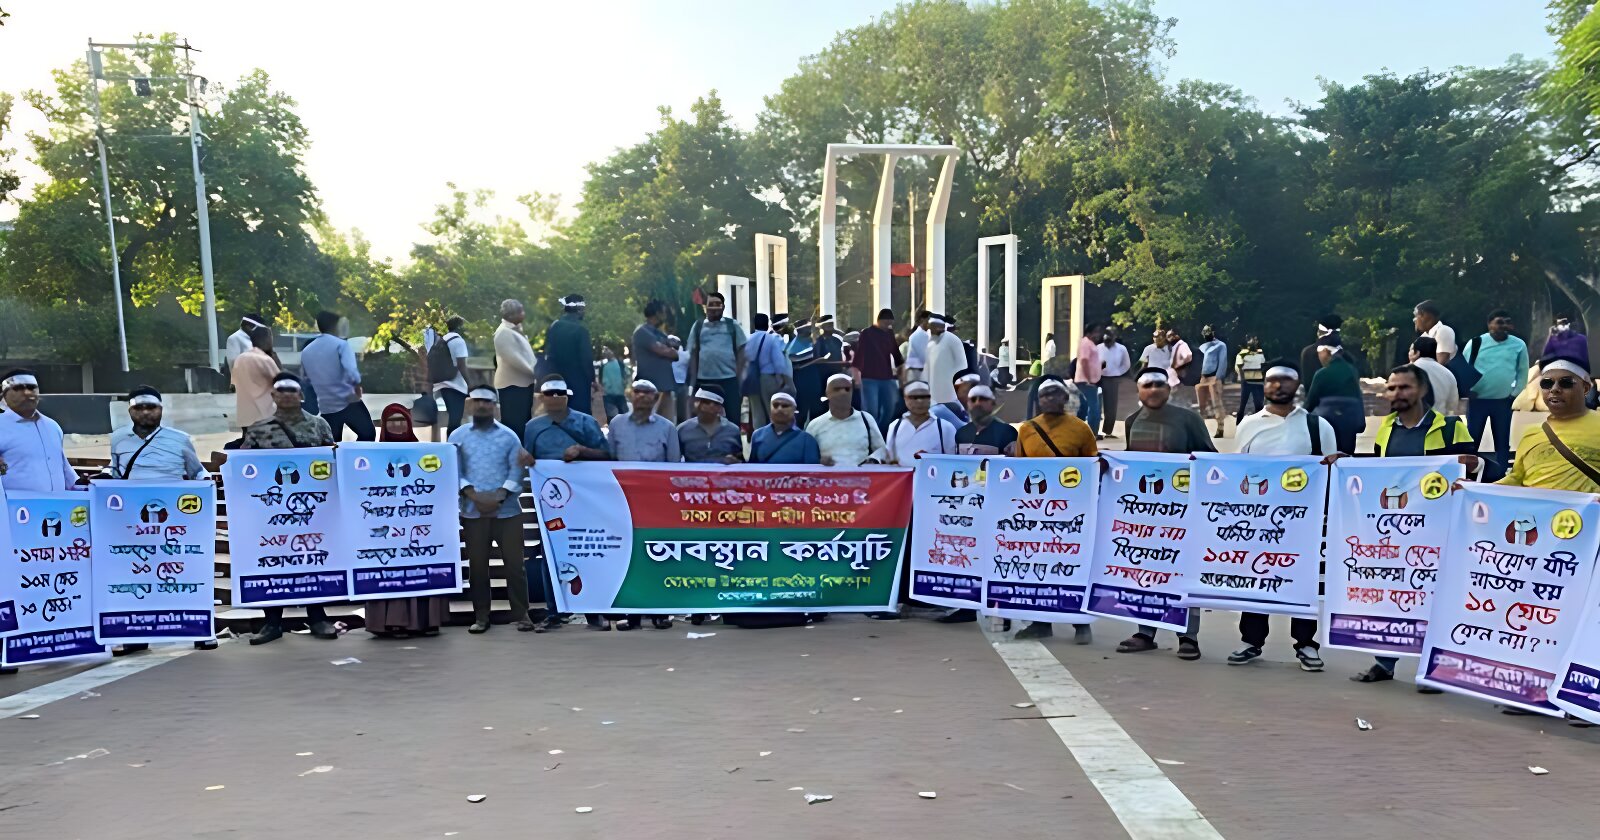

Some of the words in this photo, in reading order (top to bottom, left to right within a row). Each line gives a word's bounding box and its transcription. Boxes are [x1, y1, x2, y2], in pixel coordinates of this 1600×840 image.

[680, 508, 712, 523] ঢাকা
[644, 540, 770, 571] অবস্থান
[779, 529, 894, 570] কর্মসূচি
[1202, 547, 1250, 565] ১০ম
[1251, 551, 1300, 575] গ্রেড
[1543, 551, 1580, 578] যদি
[1531, 581, 1565, 601] হয়
[1464, 591, 1497, 612] ১০
[1505, 602, 1561, 631] গ্রেড
[1450, 622, 1494, 646] কেন
